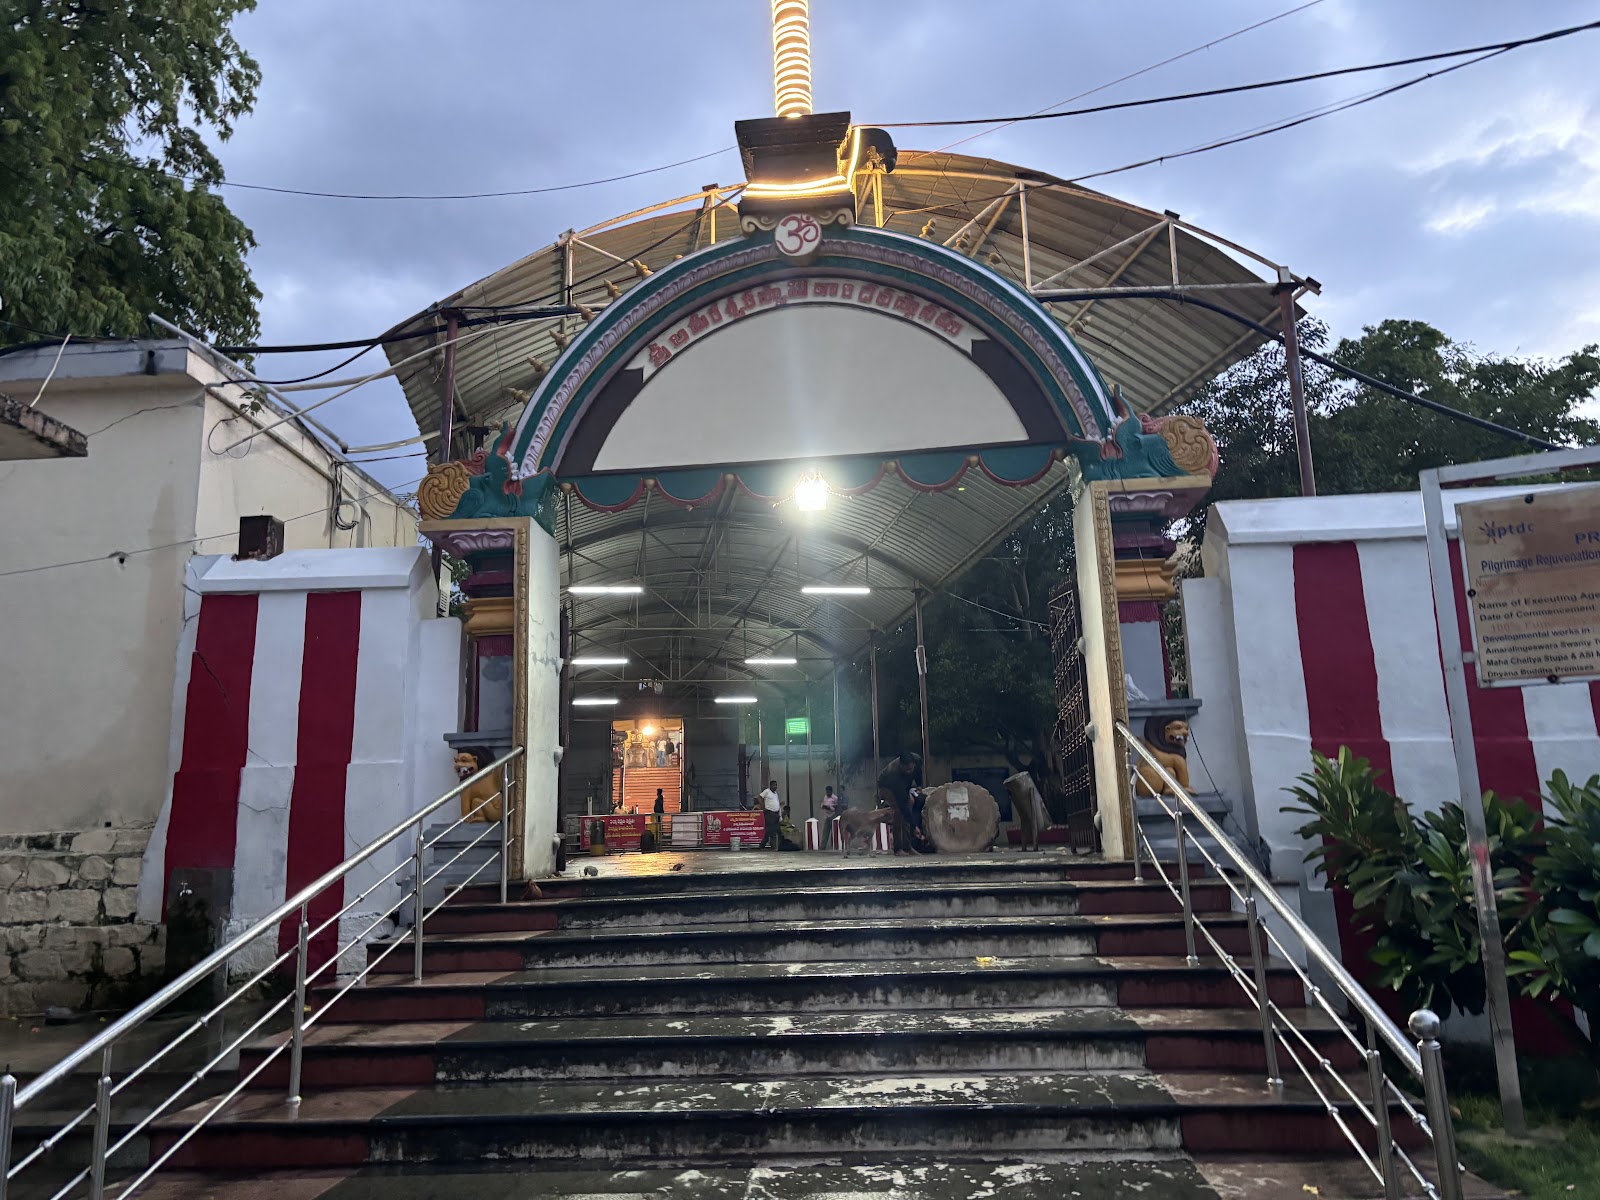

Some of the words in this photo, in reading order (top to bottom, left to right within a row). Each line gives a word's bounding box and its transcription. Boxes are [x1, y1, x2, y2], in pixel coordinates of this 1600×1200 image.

[648, 342, 673, 368] శ్రీ
[1481, 557, 1533, 574] Pilgrimage
[1536, 549, 1600, 568] Rejuvenation
[1479, 600, 1508, 610] Name
[1511, 599, 1521, 607] of
[1524, 594, 1578, 606] Executing
[1479, 612, 1501, 622] Date
[1504, 610, 1513, 619] of
[1516, 604, 1596, 618] Commencement
[1482, 630, 1550, 643] Developmental
[1551, 627, 1580, 637] works
[1485, 643, 1558, 655] Amaralingeswara
[1560, 640, 1591, 649] Swamy
[1486, 658, 1508, 667] Maha
[1510, 655, 1542, 666] Chaitya
[1544, 653, 1568, 664] Stupa
[1571, 652, 1578, 660] &
[1487, 670, 1519, 680] Dhyana
[1520, 667, 1553, 677] Buddha
[1555, 664, 1594, 675] Premises
